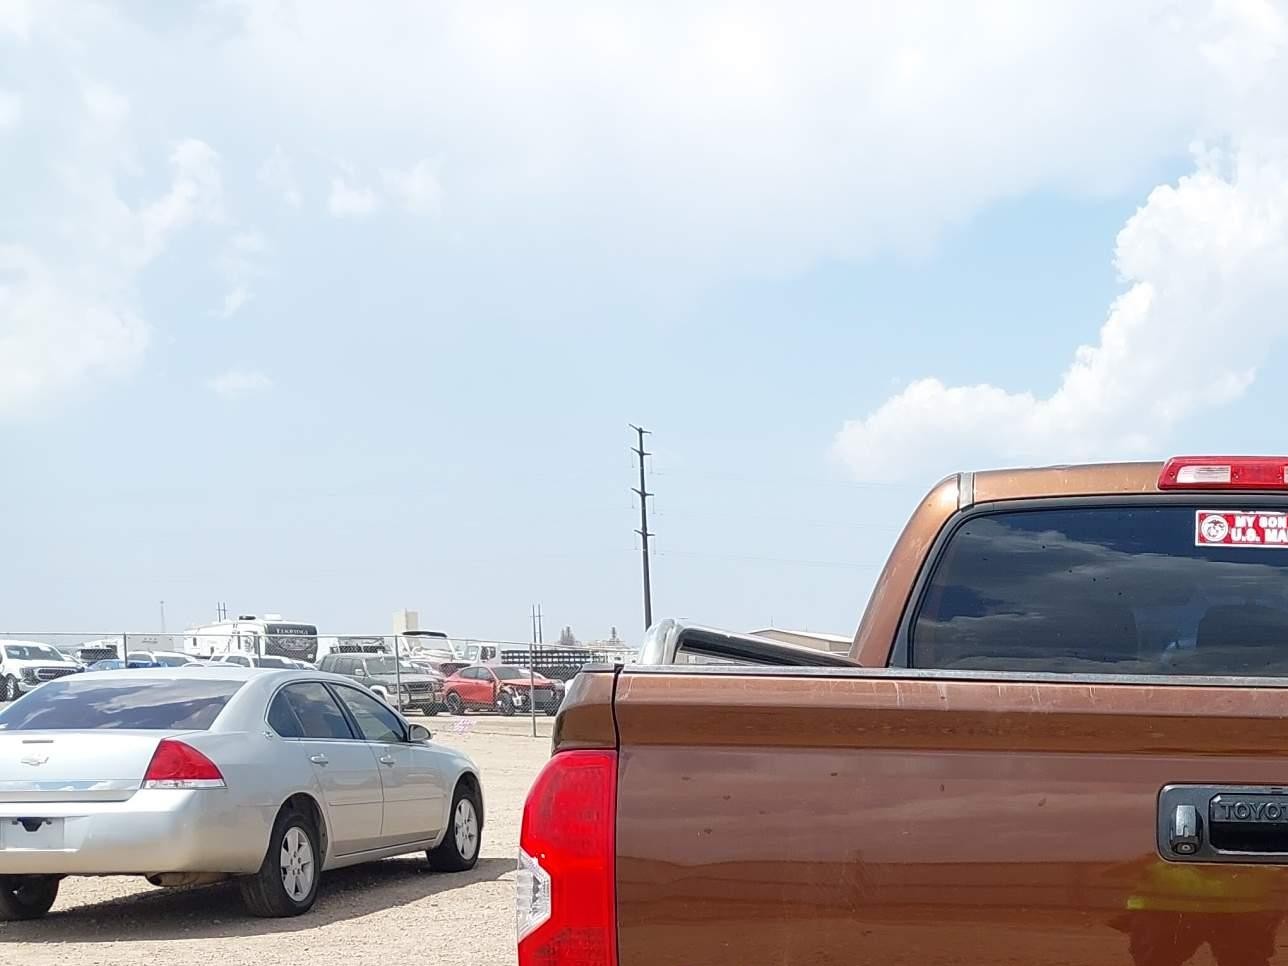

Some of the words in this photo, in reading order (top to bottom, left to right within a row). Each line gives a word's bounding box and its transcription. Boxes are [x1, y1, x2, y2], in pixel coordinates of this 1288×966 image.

[1235, 516, 1256, 527] MY
[1259, 516, 1287, 528] SON
[1231, 528, 1261, 542] U.S.
